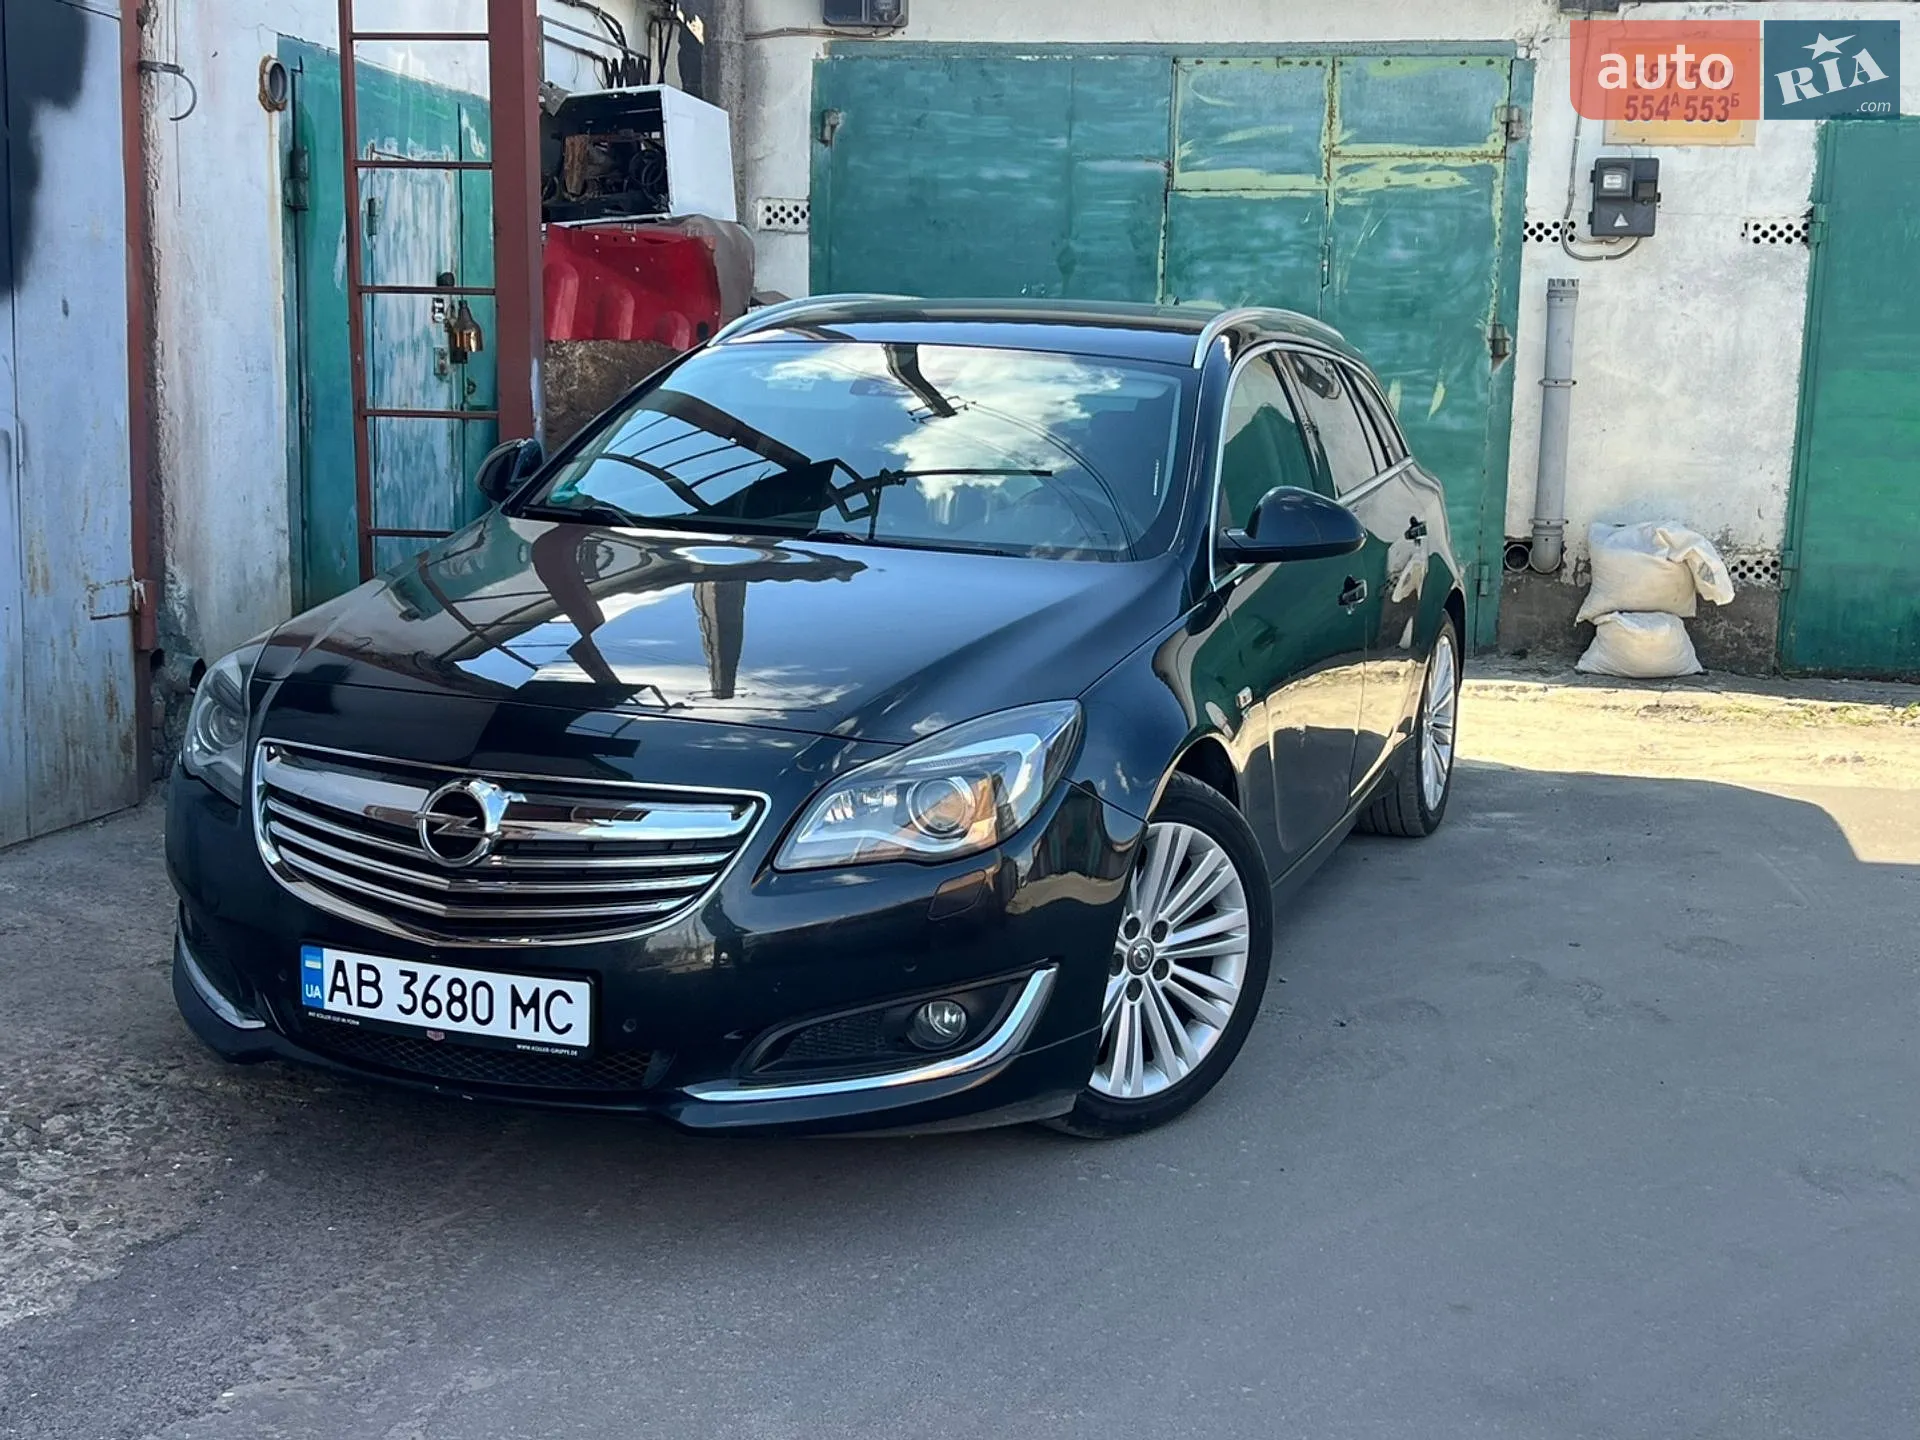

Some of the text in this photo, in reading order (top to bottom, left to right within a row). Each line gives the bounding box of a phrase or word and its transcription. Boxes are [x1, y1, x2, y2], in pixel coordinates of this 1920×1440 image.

[305, 959, 573, 1035] UA AB 3680 MC
